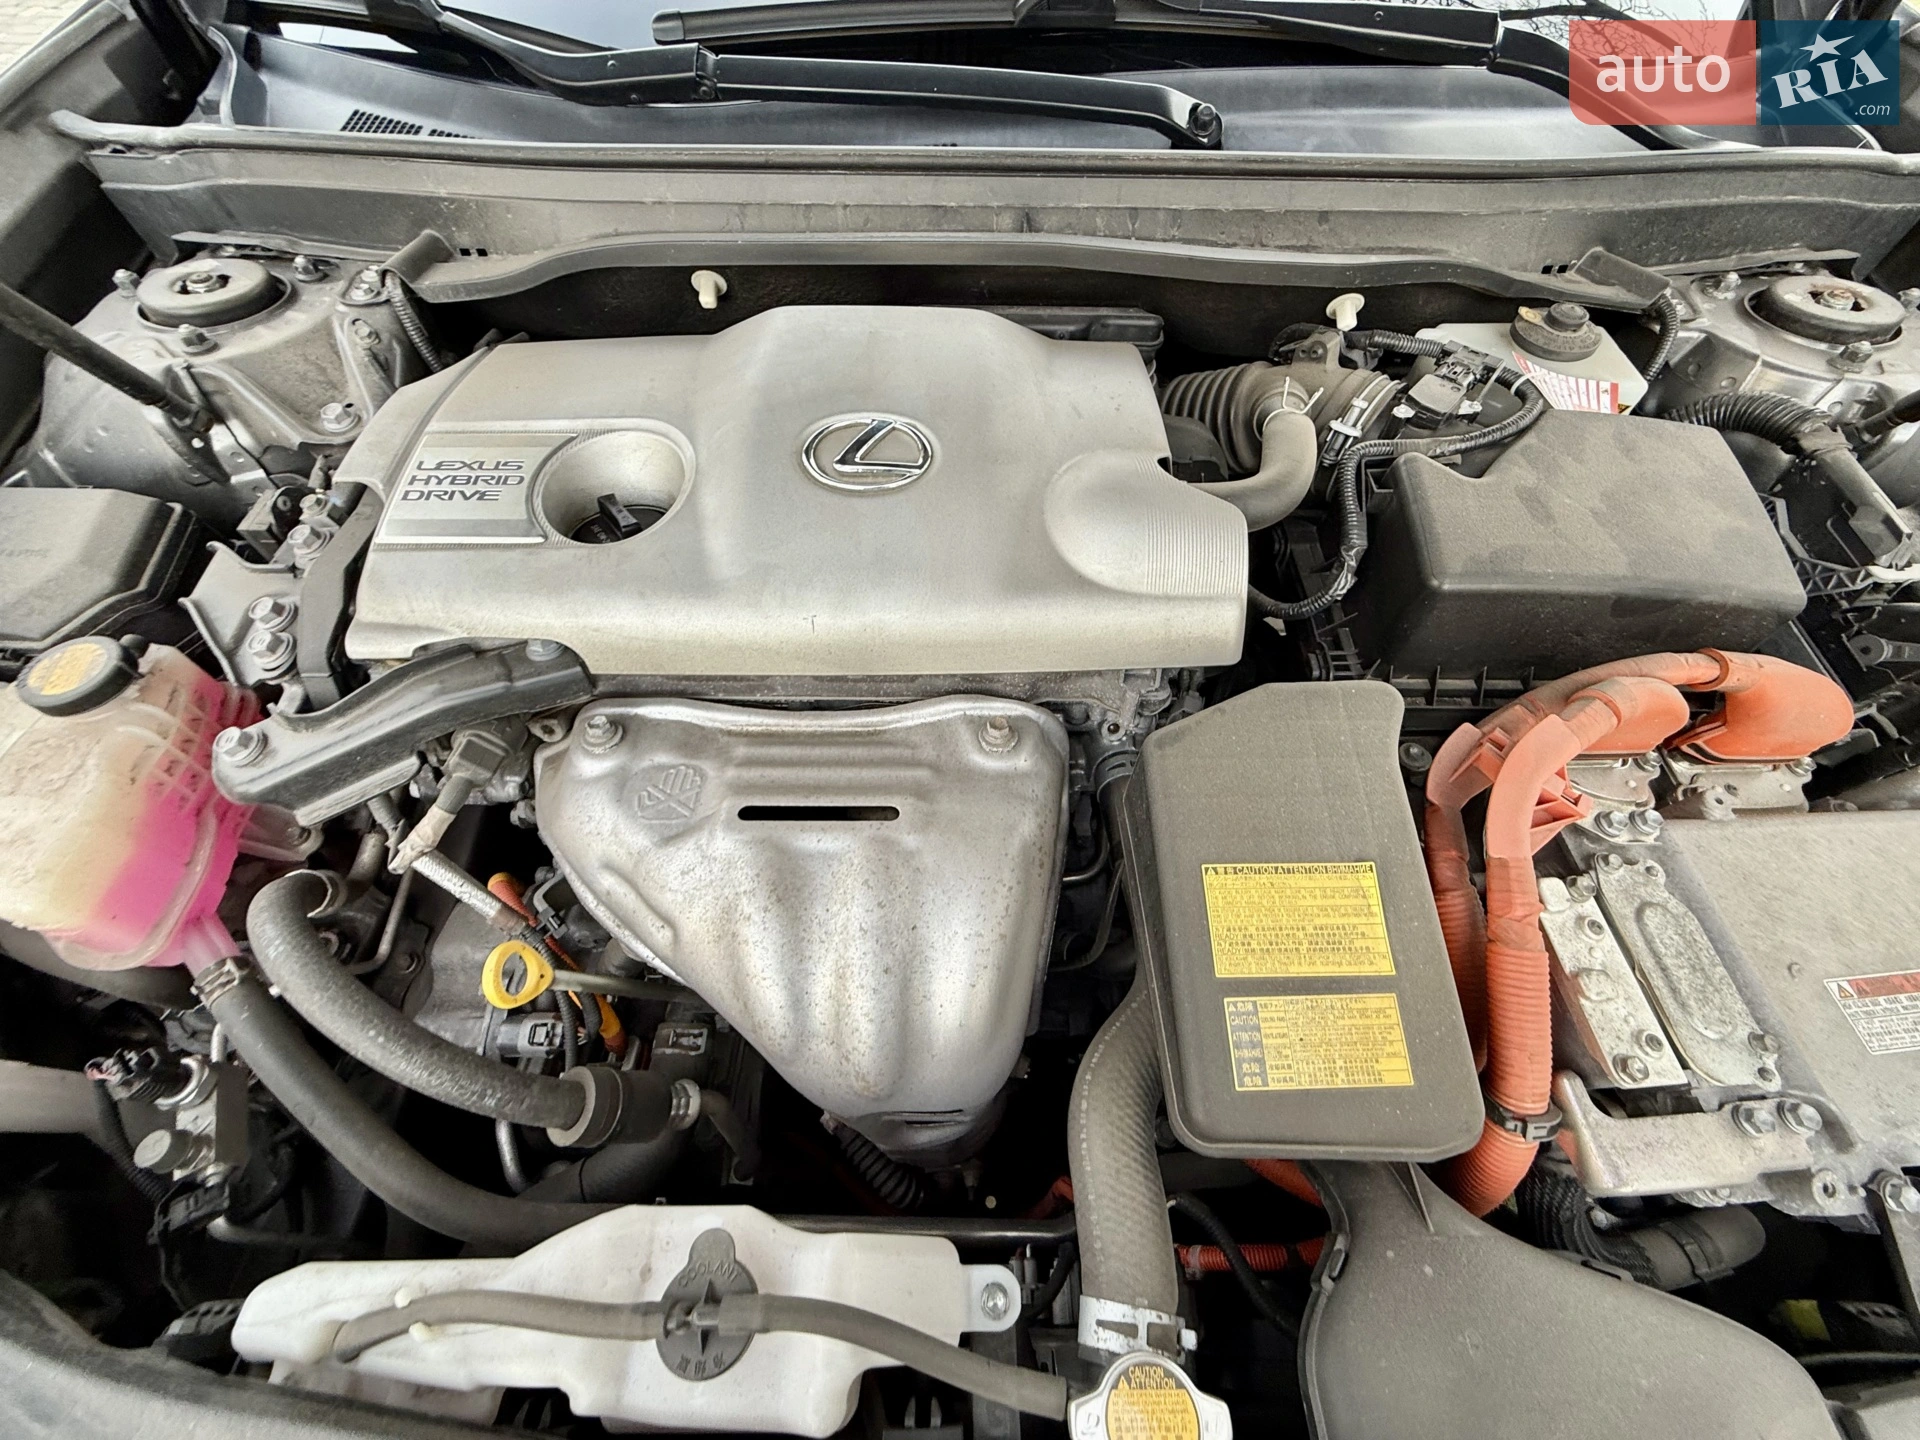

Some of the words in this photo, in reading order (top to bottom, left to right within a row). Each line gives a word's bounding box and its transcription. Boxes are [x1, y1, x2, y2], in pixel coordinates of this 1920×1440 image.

[416, 460, 525, 471] LEXUS
[407, 474, 525, 486] HYBRID
[400, 489, 503, 501] DRIVE
[1236, 866, 1275, 875] CAUTION
[1277, 865, 1326, 875] ATTENTION
[1230, 1015, 1259, 1025] CAUTION
[677, 1260, 739, 1288] COOLANT
[1128, 1366, 1164, 1378] CAUTION
[1130, 1377, 1176, 1390] ATTENTION
